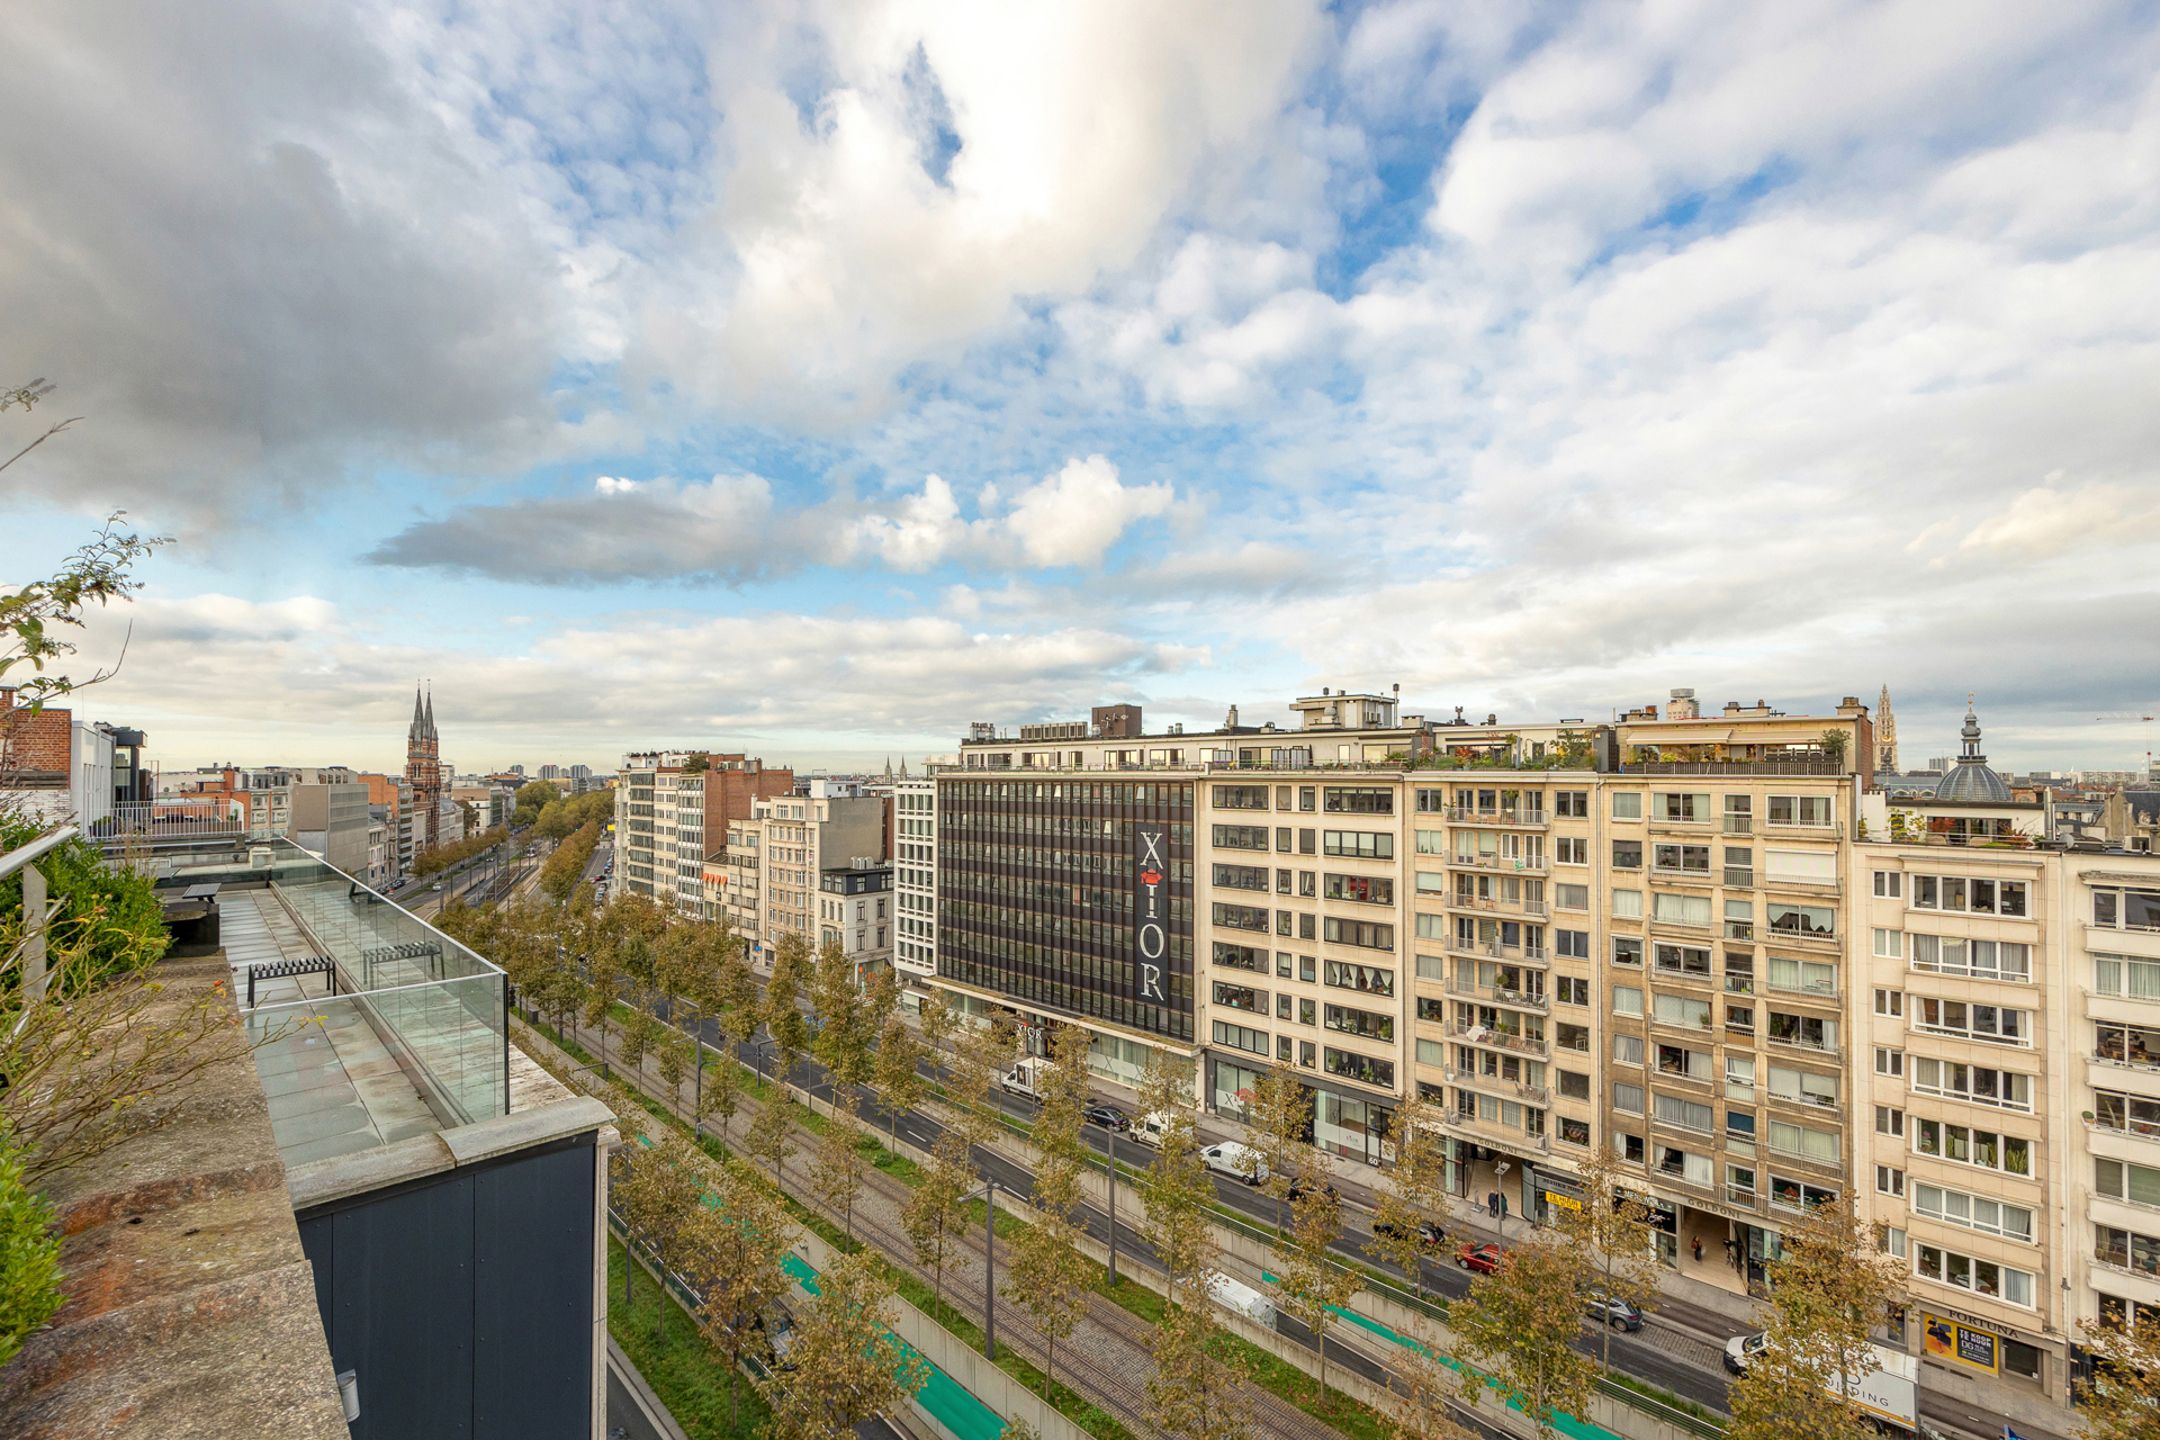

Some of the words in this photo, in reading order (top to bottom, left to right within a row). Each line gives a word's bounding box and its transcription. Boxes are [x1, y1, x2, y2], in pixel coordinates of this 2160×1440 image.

[1139, 831, 1165, 1001] XIOR
[1478, 1138, 1519, 1155] GOLDONI
[1368, 1157, 1378, 1166] 60
[1688, 1198, 1740, 1219] GOLDONI
[1948, 1310, 2019, 1338] FORTUNA
